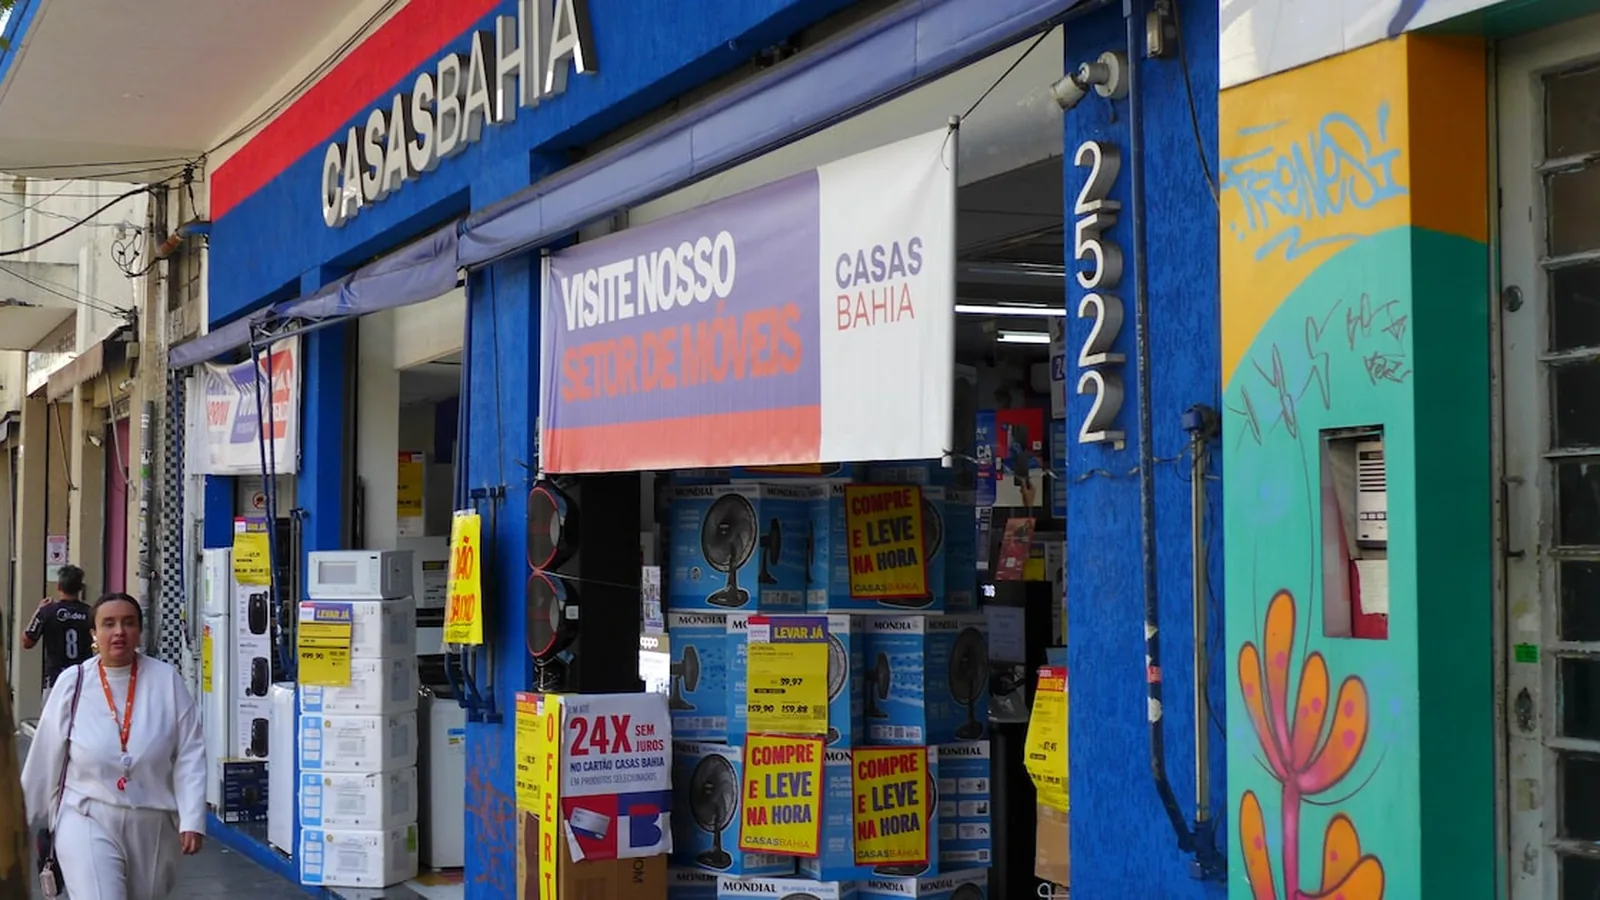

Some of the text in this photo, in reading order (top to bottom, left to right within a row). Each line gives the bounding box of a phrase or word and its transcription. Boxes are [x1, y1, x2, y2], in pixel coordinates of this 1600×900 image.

[835, 236, 923, 289] CASAS
[561, 230, 736, 331] VISITE NOSSO
[837, 282, 915, 331] BAHIA
[562, 300, 801, 403] SETOR DE MÓVEIS
[852, 488, 912, 516] COMPRE
[853, 515, 915, 548] E LEVE
[853, 548, 918, 574] NA HORA
[65, 628, 78, 660] 8
[773, 627, 808, 639] LEVAR
[810, 625, 824, 639] JÁ
[569, 714, 655, 756] 24X SEM
[636, 739, 664, 752] JUROS
[570, 757, 665, 772] NO CARTÃO CASAS BAHIA
[751, 743, 814, 768] COMPRE
[858, 752, 919, 780] COMPRE
[581, 775, 612, 786] PRODUTOS
[749, 771, 813, 800] E LEVE
[858, 780, 919, 814] E LEVE
[747, 803, 812, 826] NA HORA
[858, 814, 920, 840] NA HORA
[722, 881, 777, 893] MONDIAL
